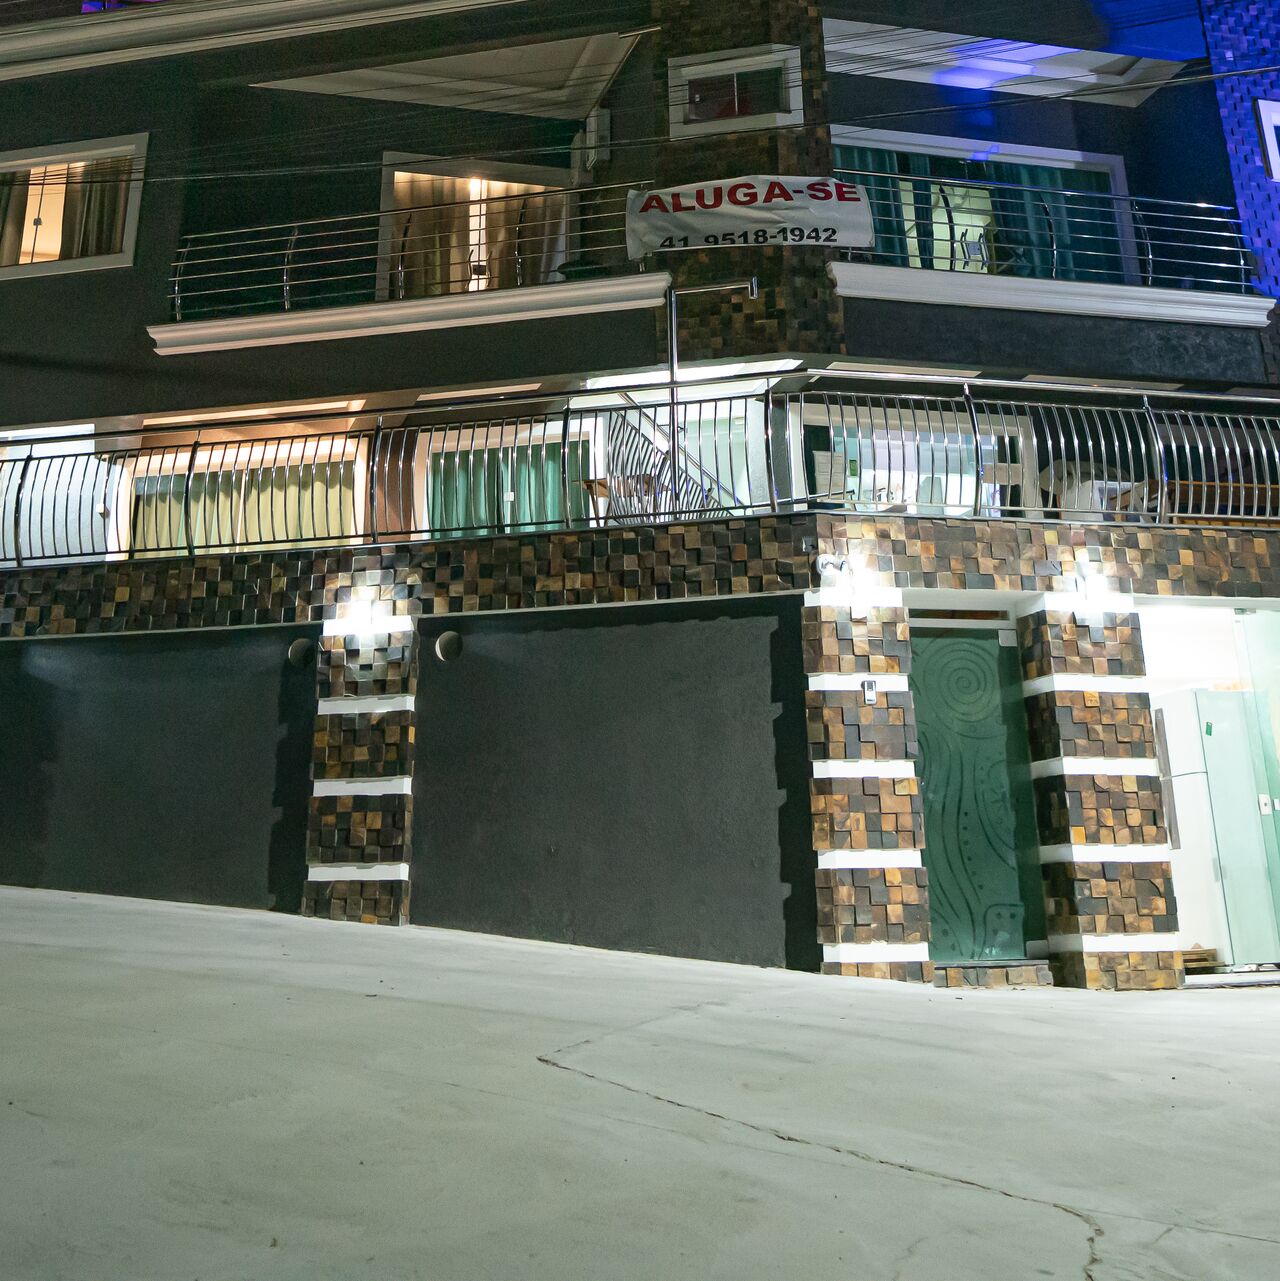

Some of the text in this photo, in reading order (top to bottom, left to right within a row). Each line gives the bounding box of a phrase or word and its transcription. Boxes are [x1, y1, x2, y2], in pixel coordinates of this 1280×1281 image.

[639, 181, 862, 213] ALUGA-SE
[659, 227, 838, 248] 41 9518-1942
